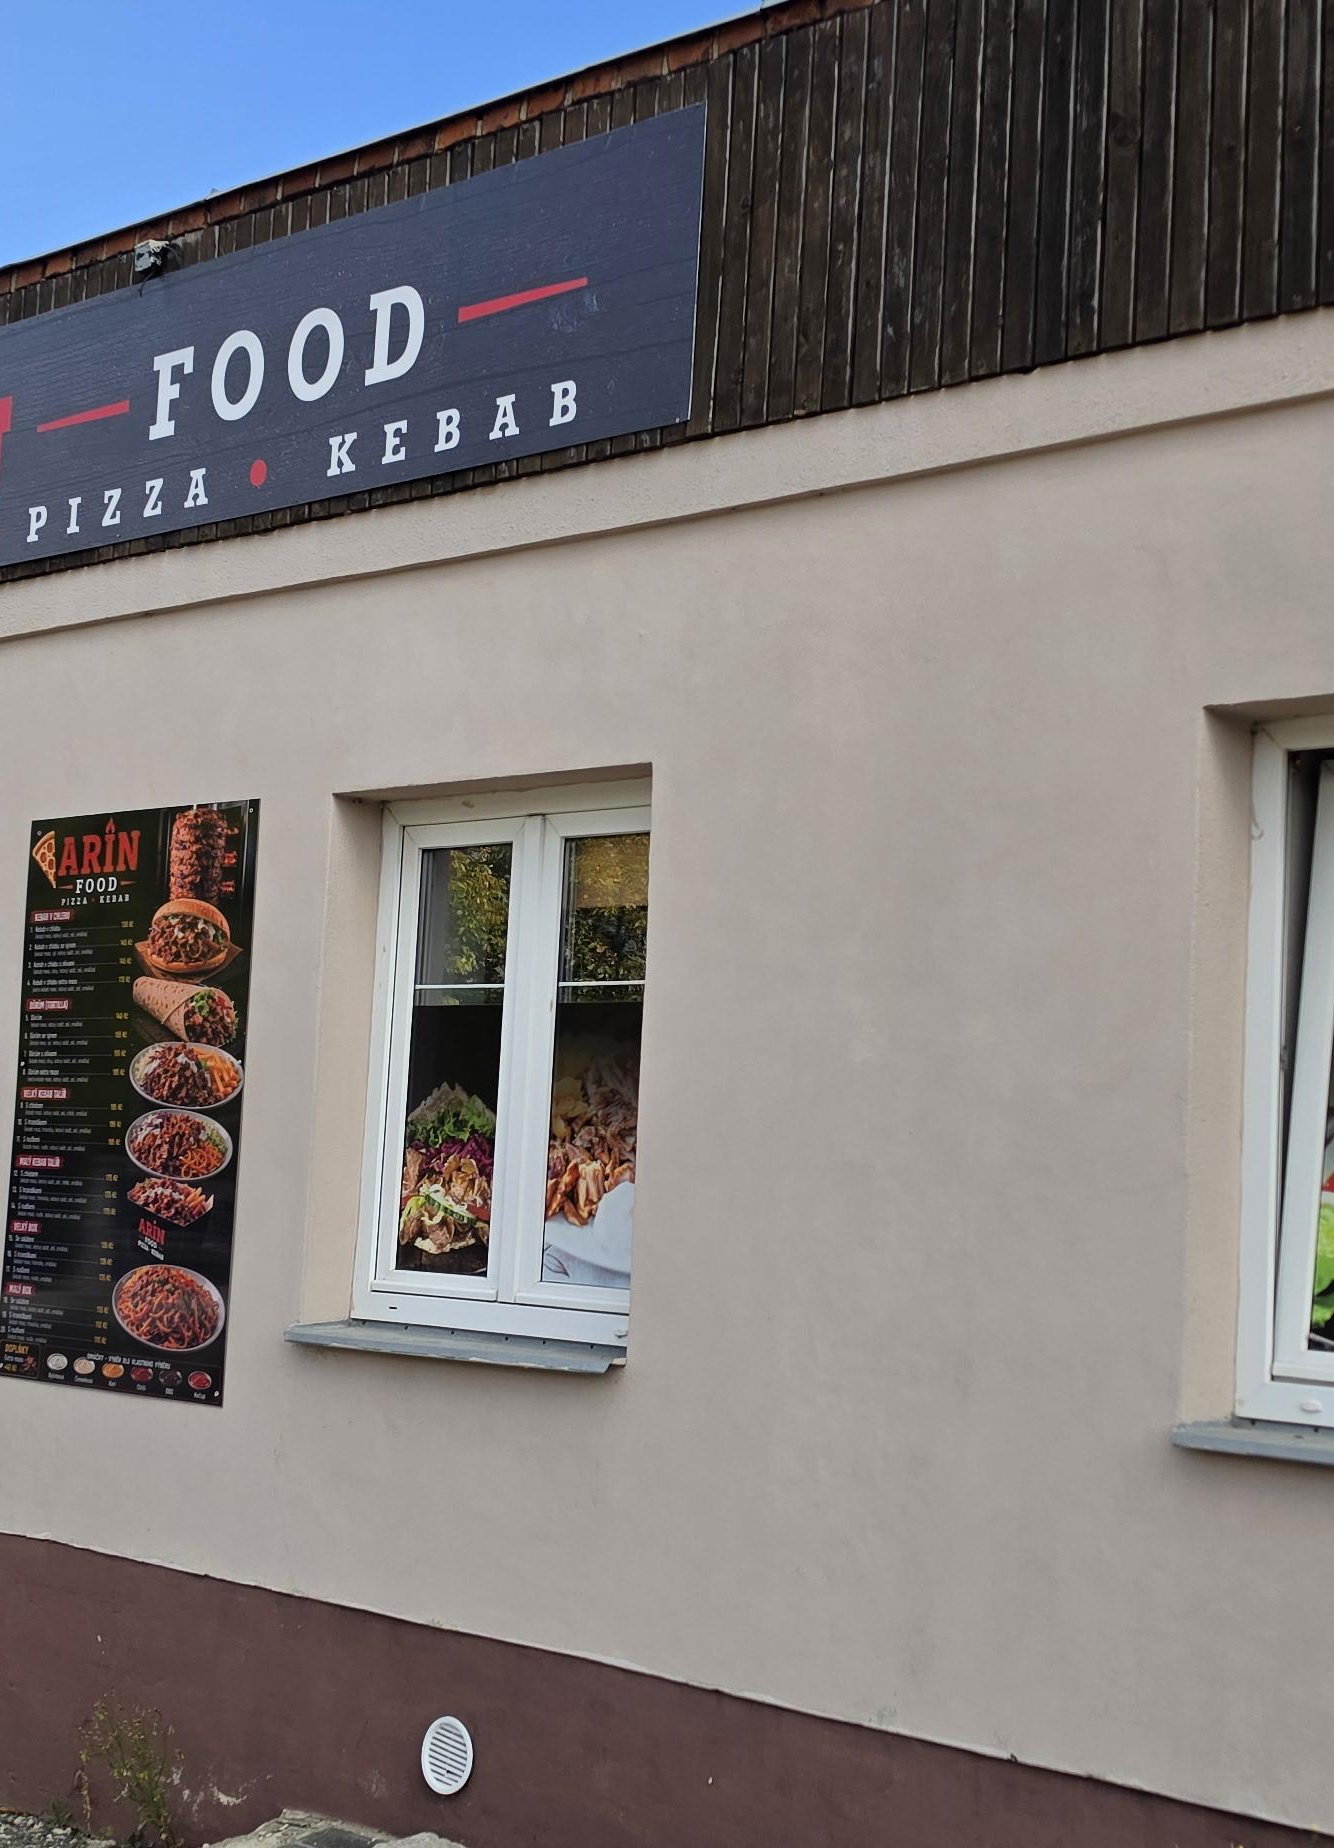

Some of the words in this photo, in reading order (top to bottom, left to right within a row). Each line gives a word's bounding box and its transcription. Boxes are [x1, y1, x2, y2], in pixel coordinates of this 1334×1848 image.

[148, 285, 427, 442] FOOD
[26, 467, 210, 543] PIZZA
[327, 380, 581, 478] KEBAB
[61, 896, 88, 906] PIZZA
[99, 893, 130, 904] KEBAB
[75, 876, 118, 894] FOOD
